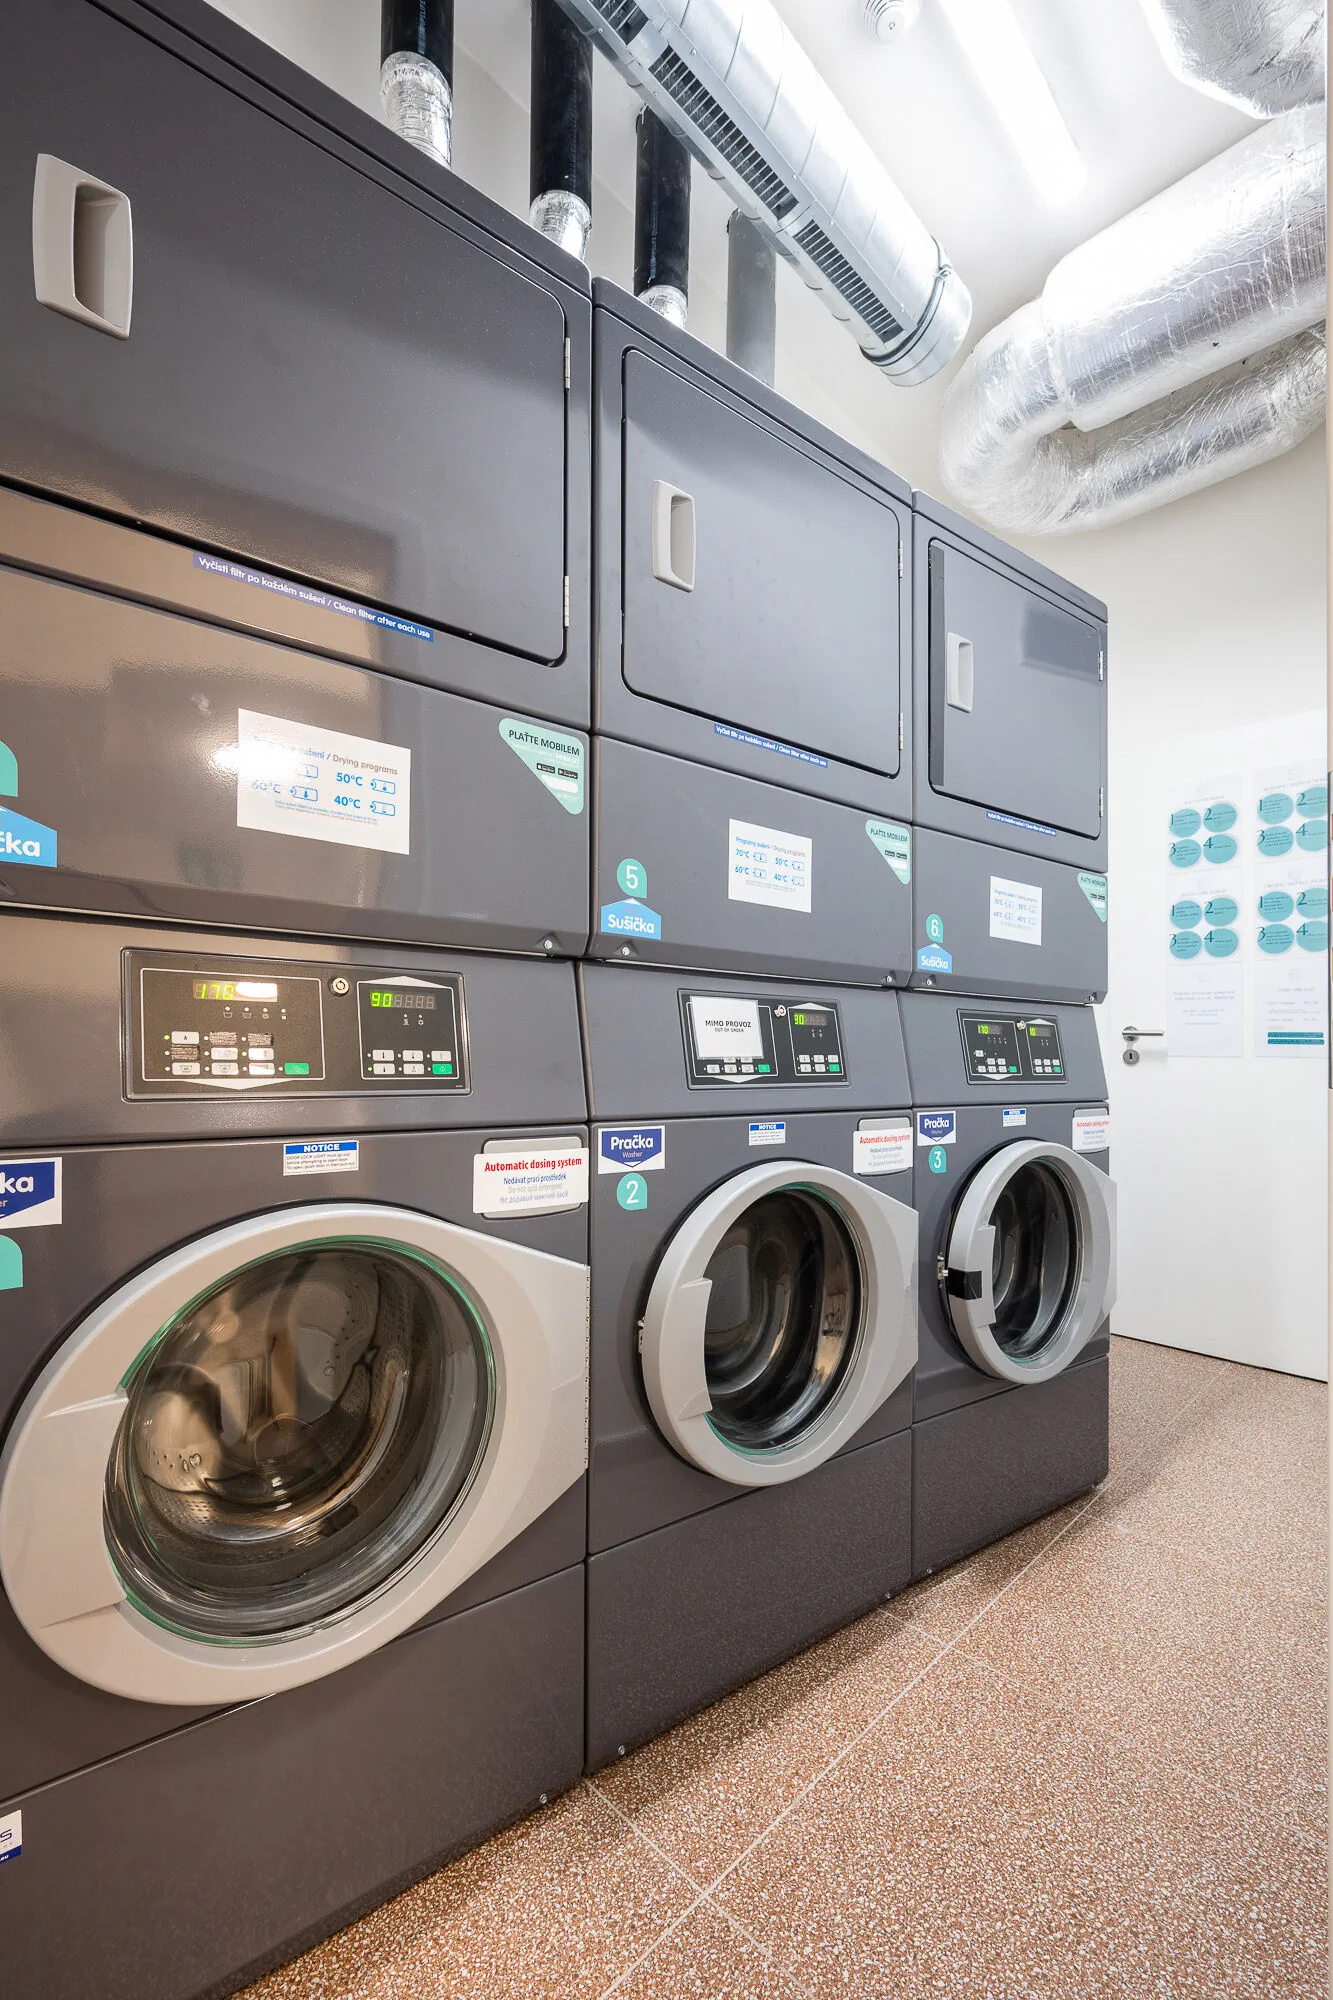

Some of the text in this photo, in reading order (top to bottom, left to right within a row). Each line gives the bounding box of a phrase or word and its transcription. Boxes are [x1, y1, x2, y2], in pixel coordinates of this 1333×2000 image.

[230, 567, 246, 579] filtr
[247, 574, 260, 585] po
[333, 601, 357, 615] Clean
[358, 608, 376, 621] filter
[377, 616, 397, 627] after
[397, 623, 416, 634] each
[417, 629, 431, 638] use
[540, 738, 580, 756] MOBILEM
[333, 754, 359, 768] Drying
[360, 760, 398, 776] programs
[336, 772, 363, 787] 50°C
[334, 795, 361, 809] 40°C
[1296, 793, 1307, 806] 2
[1204, 808, 1213, 820] 2
[1296, 823, 1308, 836] 4
[1203, 837, 1214, 848] 4
[1257, 830, 1265, 845] 3
[1169, 842, 1176, 857] 3
[626, 865, 638, 889] 5
[1297, 892, 1307, 905] 2
[1204, 902, 1214, 913] 2
[608, 913, 655, 934] Sušička
[1296, 923, 1308, 936] 4
[1169, 933, 1177, 948] 3
[1204, 930, 1214, 942] 4
[1257, 926, 1266, 942] 3
[371, 992, 392, 1008] 90
[725, 1020, 752, 1028] PROVOZ
[303, 1143, 340, 1153] NOTICE
[610, 1134, 654, 1151] Pračka
[485, 1157, 582, 1172] Automatic dosing system
[934, 1150, 942, 1169] 3
[626, 1180, 639, 1204] 2
